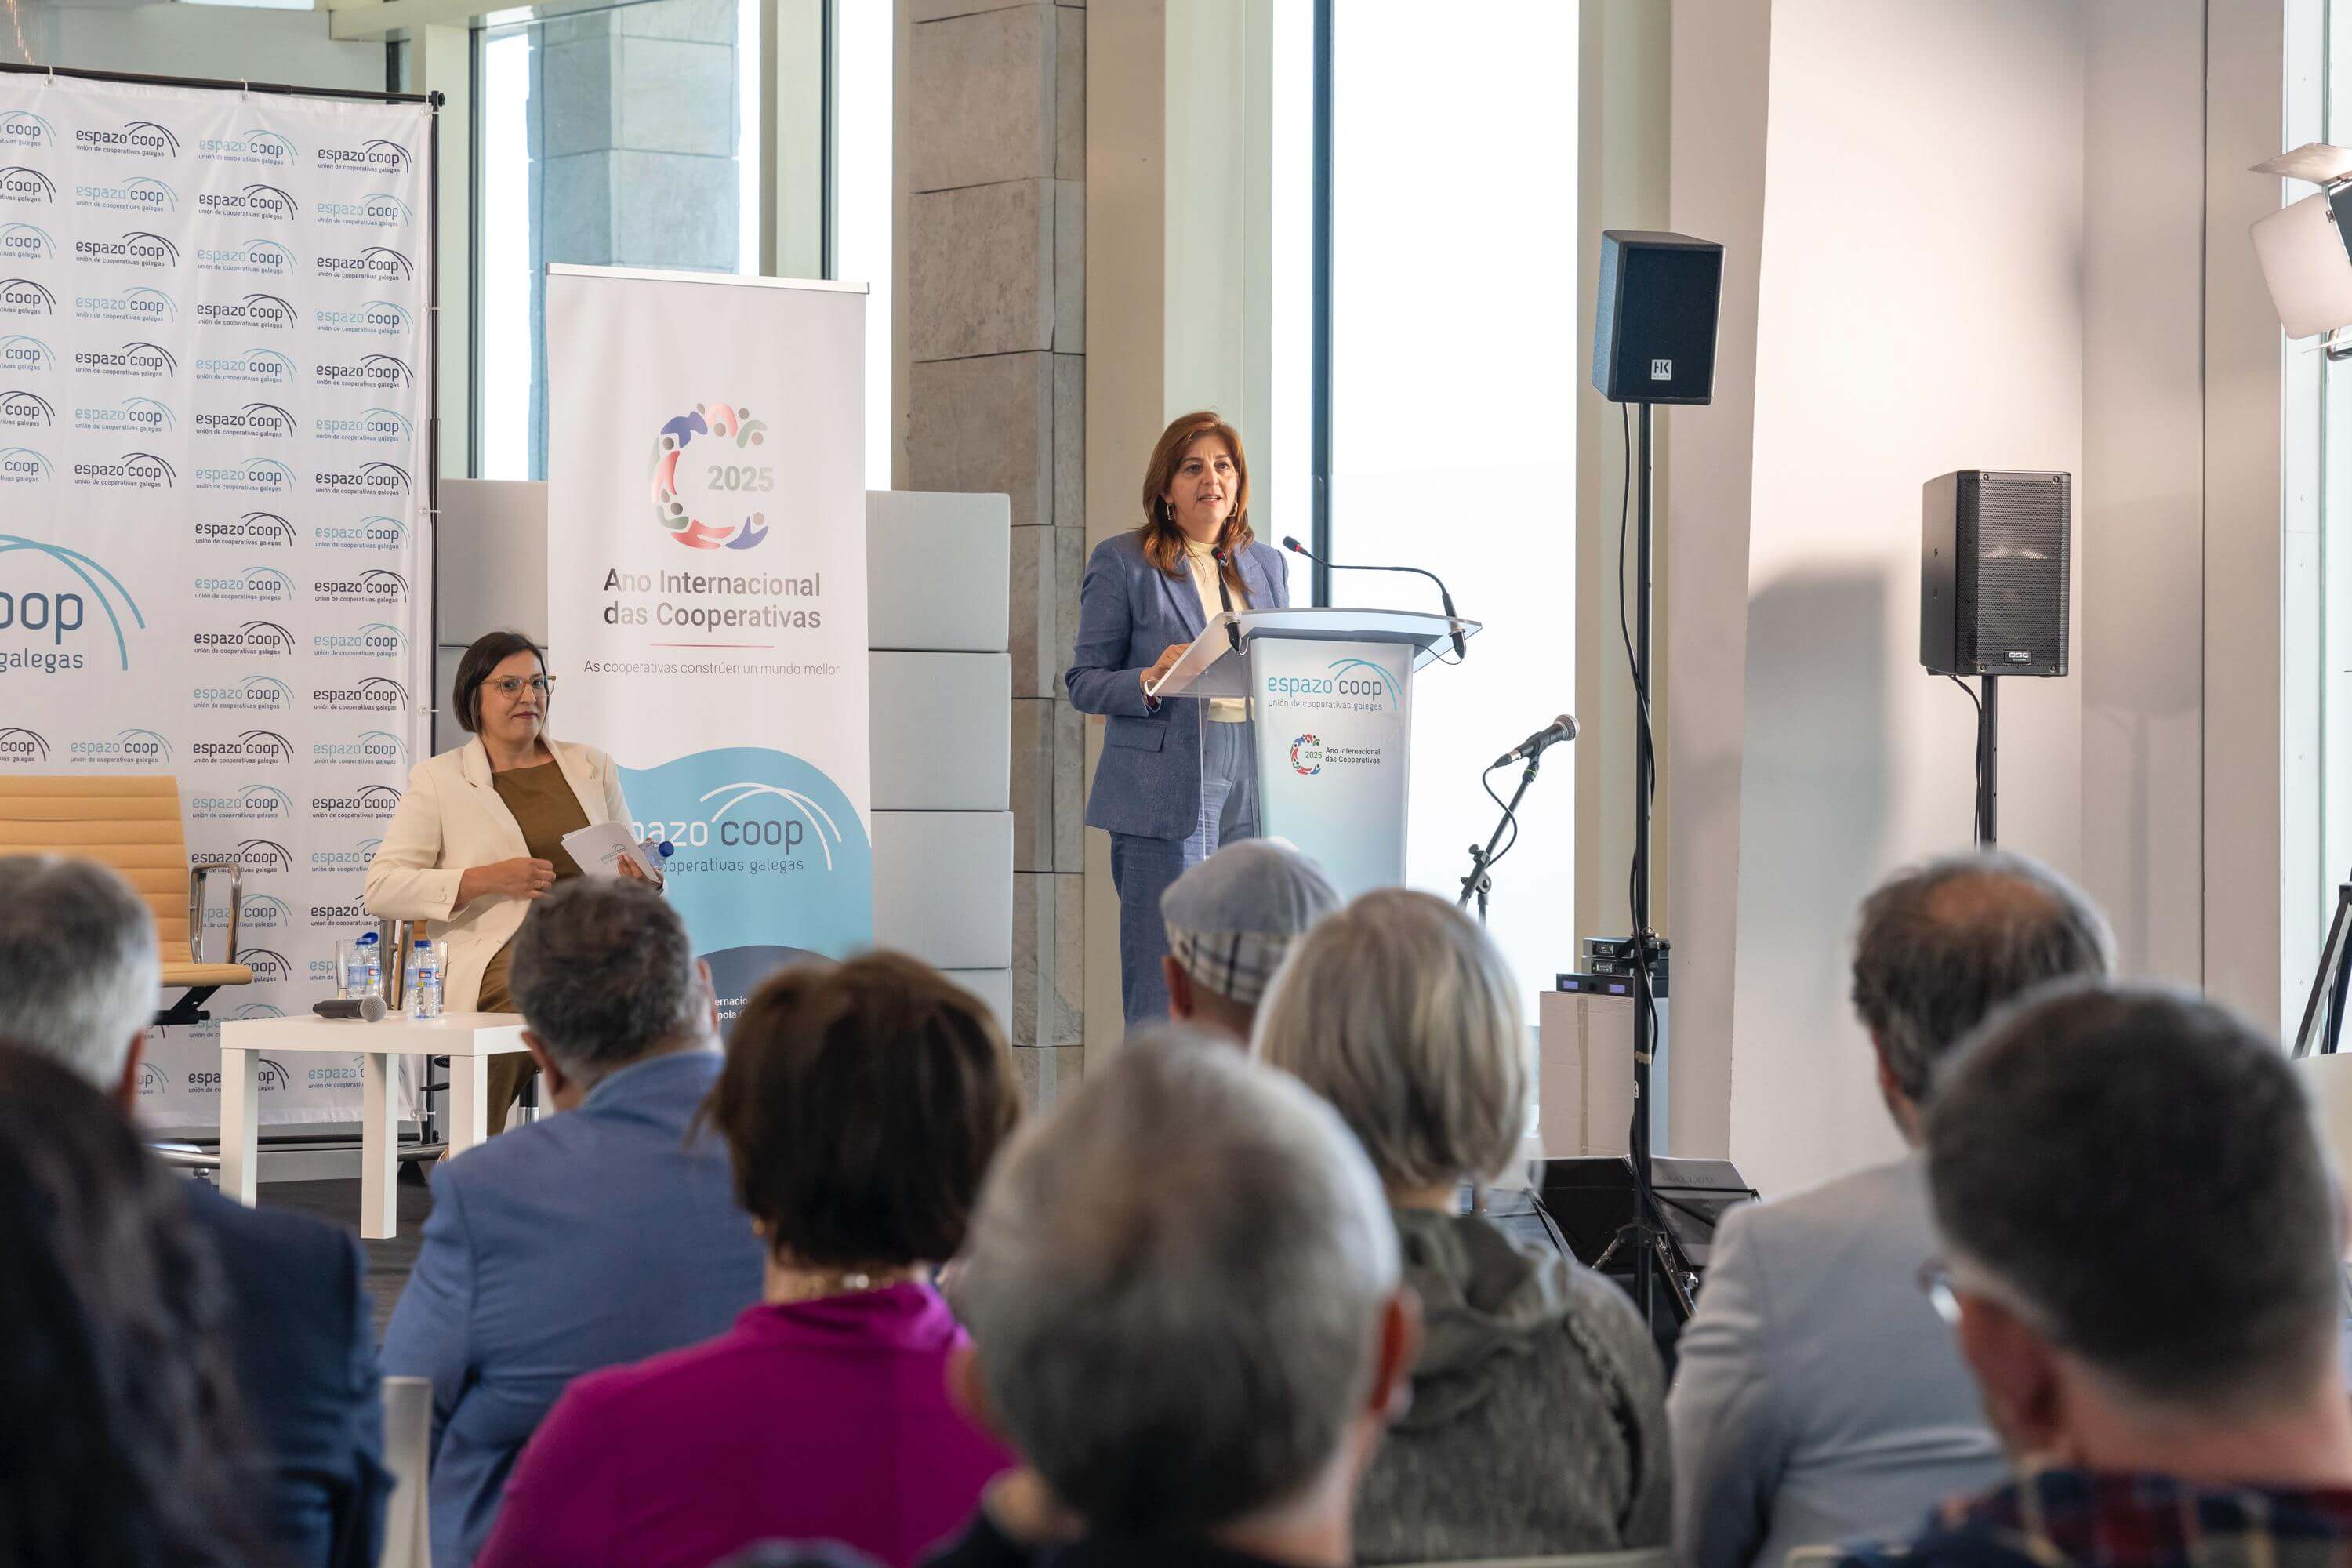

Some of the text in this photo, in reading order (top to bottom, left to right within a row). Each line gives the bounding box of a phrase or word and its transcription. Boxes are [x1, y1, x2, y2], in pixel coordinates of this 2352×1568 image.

[6, 124, 41, 140] coop
[76, 130, 165, 151] espazo coop
[198, 139, 283, 158] espazo coop
[318, 148, 400, 167] espazo coop
[6, 180, 41, 196] coop
[75, 186, 164, 205] espazo coop
[198, 194, 282, 213] espazo coop
[317, 203, 399, 220] espazo coop
[6, 236, 40, 252] coop
[75, 241, 164, 260] espazo coop
[197, 249, 283, 267] espazo coop
[317, 256, 399, 274] espazo coop
[6, 292, 40, 308] coop
[75, 297, 164, 315] espazo coop
[196, 303, 283, 322] espazo coop
[316, 310, 400, 328] espazo coop
[6, 348, 40, 364] coop
[75, 352, 163, 371] espazo coop
[196, 359, 283, 376] espazo coop
[316, 365, 399, 382] espazo coop
[1654, 361, 1669, 374] HK
[6, 405, 39, 419] coop
[75, 408, 162, 426] espazo coop
[196, 413, 282, 431] espazo coop
[316, 419, 399, 435] espazo coop
[5, 461, 38, 475] coop
[74, 463, 162, 481] espazo coop
[195, 469, 281, 485] espazo coop
[315, 473, 399, 489] espazo coop
[707, 465, 775, 492] 2025
[195, 523, 281, 539] espazo coop
[314, 527, 399, 543] espazo coop
[194, 579, 281, 594] espazo coop
[314, 581, 398, 597] espazo coop
[604, 568, 821, 597] Ano Internacional
[604, 600, 822, 633] das Cooperativas
[194, 633, 281, 648] espazo coop
[314, 635, 397, 651] espazo coop
[0, 648, 83, 673] galegas
[583, 660, 840, 676] As cooperativas constrúen un mundo mellor
[194, 688, 280, 703] espazo coop
[313, 689, 397, 704] espazo coop
[1268, 677, 1382, 701] espazo coop
[1268, 699, 1289, 707] unión
[1302, 700, 1351, 710] cooperativas
[1353, 701, 1383, 711] galegas
[1, 742, 34, 756] coop
[70, 742, 158, 757] espazo coop
[193, 742, 279, 757] espazo coop
[313, 743, 397, 758] espazo coop
[1340, 747, 1381, 756] Internacional
[1338, 756, 1381, 765] Cooperativas
[192, 797, 278, 812] espazo coop
[312, 797, 396, 812] espazo coop
[721, 819, 804, 855] coop
[245, 853, 278, 866] coop
[311, 851, 359, 866] espazo
[750, 858, 804, 874] galegas
[244, 907, 277, 920] coop
[310, 906, 358, 920] espazo
[714, 996, 747, 1005] ernacio
[717, 1010, 736, 1022] pola
[188, 1073, 220, 1087] espa
[308, 1068, 356, 1083] espazo
